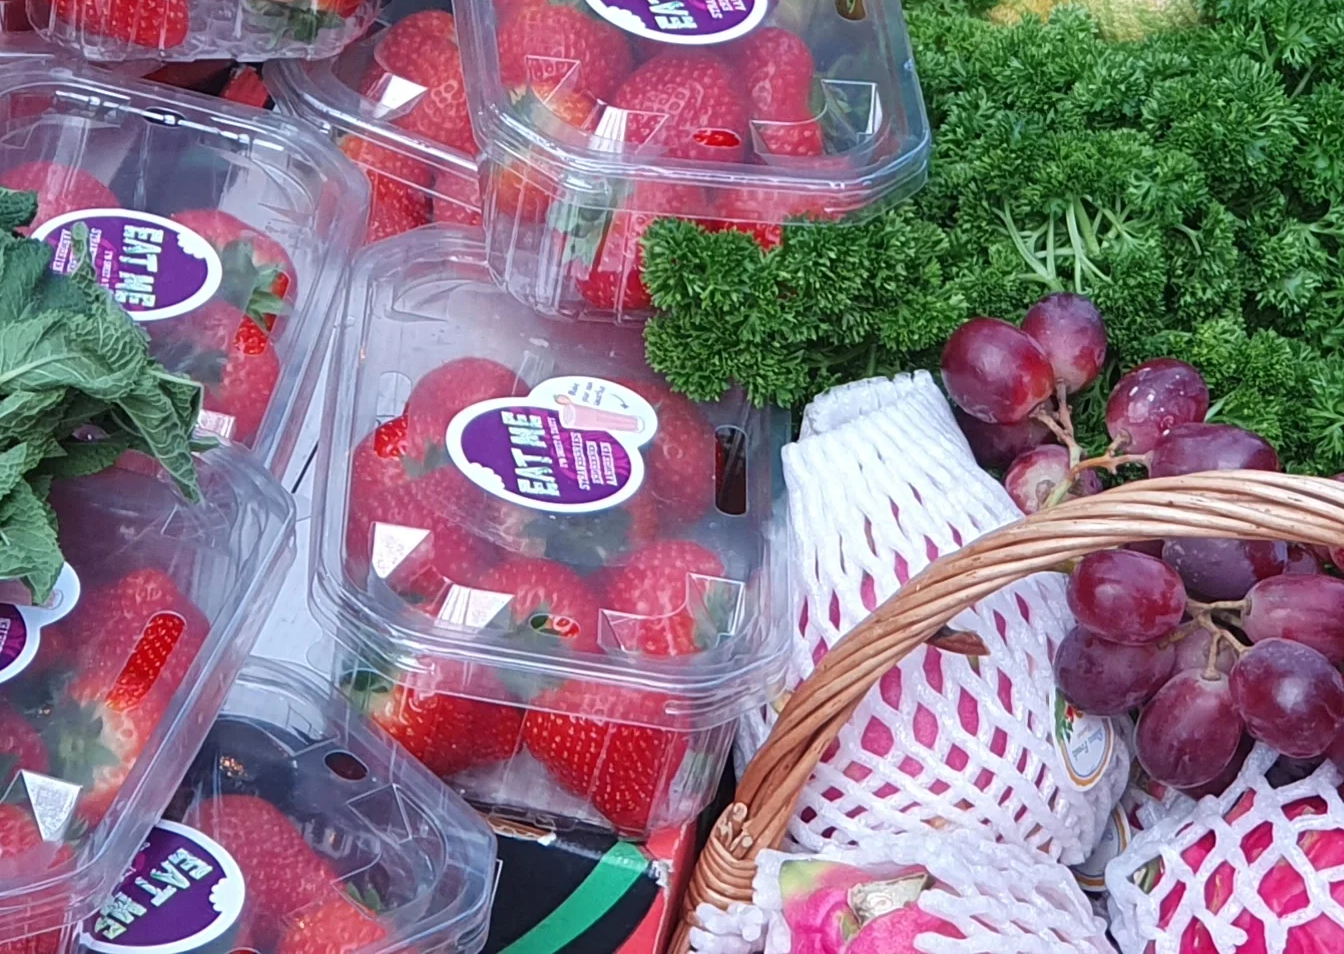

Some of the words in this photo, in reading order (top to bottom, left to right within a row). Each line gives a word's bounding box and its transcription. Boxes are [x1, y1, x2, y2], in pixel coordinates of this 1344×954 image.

[118, 224, 164, 273] EAT
[114, 271, 156, 307] ME
[500, 410, 548, 448] ME
[511, 447, 561, 497] EAT
[134, 847, 213, 907] EAT
